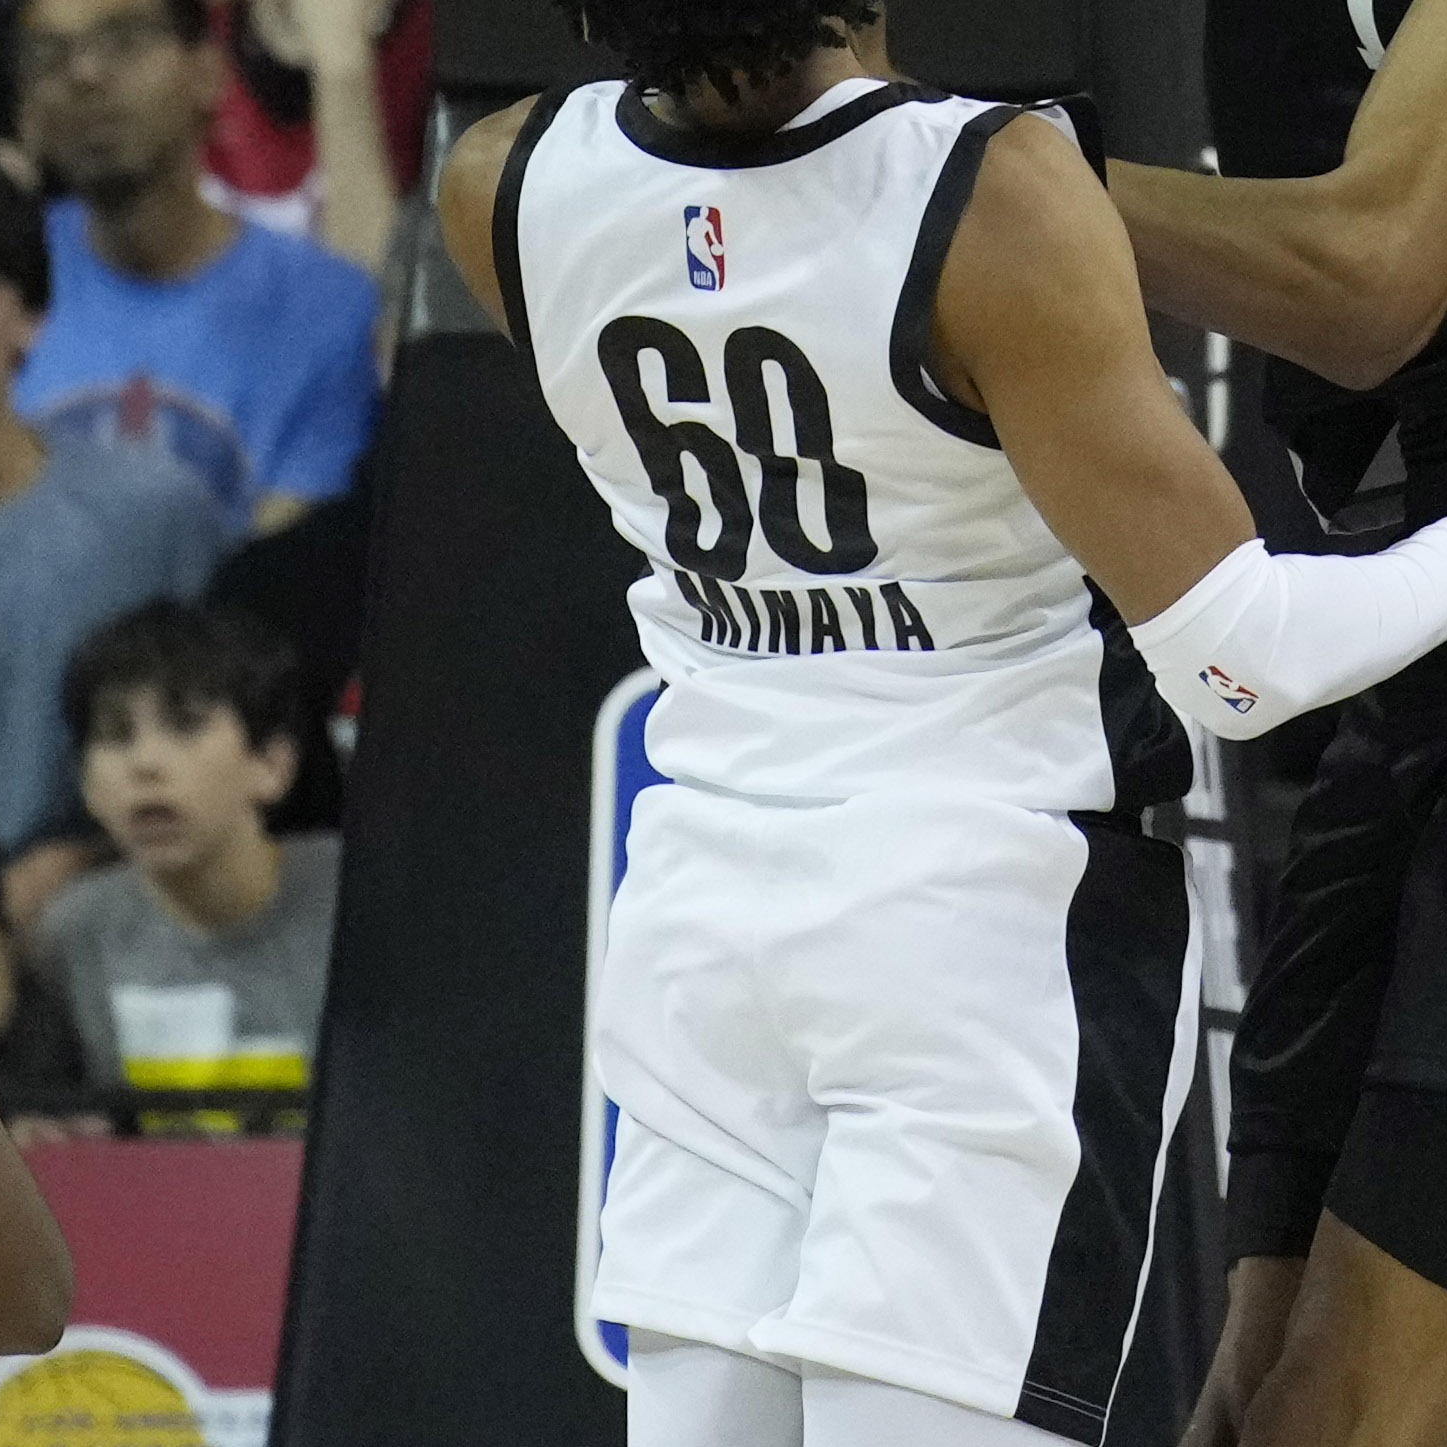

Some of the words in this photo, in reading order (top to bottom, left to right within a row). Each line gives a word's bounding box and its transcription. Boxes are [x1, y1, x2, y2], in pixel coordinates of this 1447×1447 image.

[693, 270, 713, 286] NBA
[597, 315, 878, 582] 60
[674, 568, 935, 655] MINAYA
